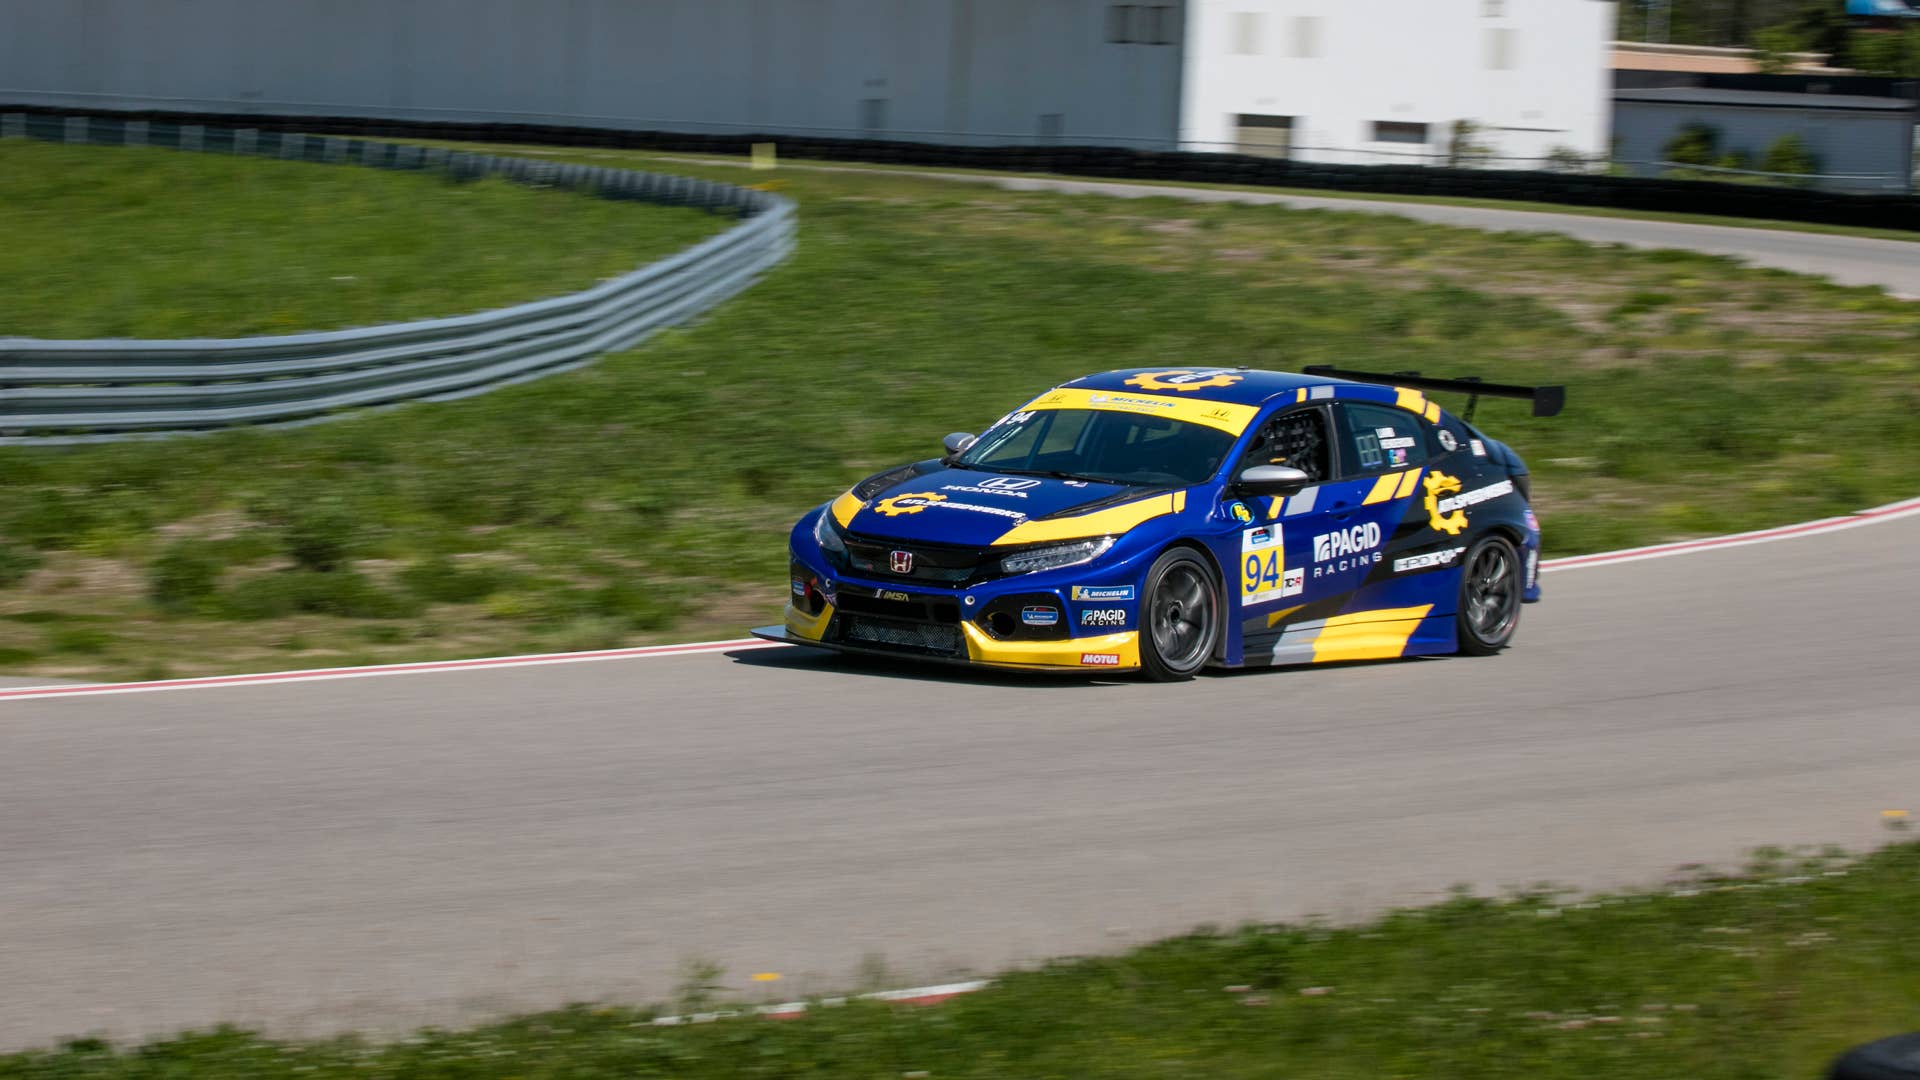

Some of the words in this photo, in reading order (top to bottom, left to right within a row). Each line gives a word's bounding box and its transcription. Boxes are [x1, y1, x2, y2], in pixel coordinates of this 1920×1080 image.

[1111, 396, 1176, 408] MICHELIN
[1006, 411, 1036, 425] 94
[942, 485, 1028, 498] HONDA
[1330, 521, 1381, 558] PAGID
[1313, 551, 1383, 578] RACING
[1245, 550, 1279, 592] 94
[1284, 576, 1302, 588] TCR
[883, 590, 910, 602] IMSA
[1093, 609, 1126, 620] PAGID
[1083, 654, 1118, 664] MOTUL
